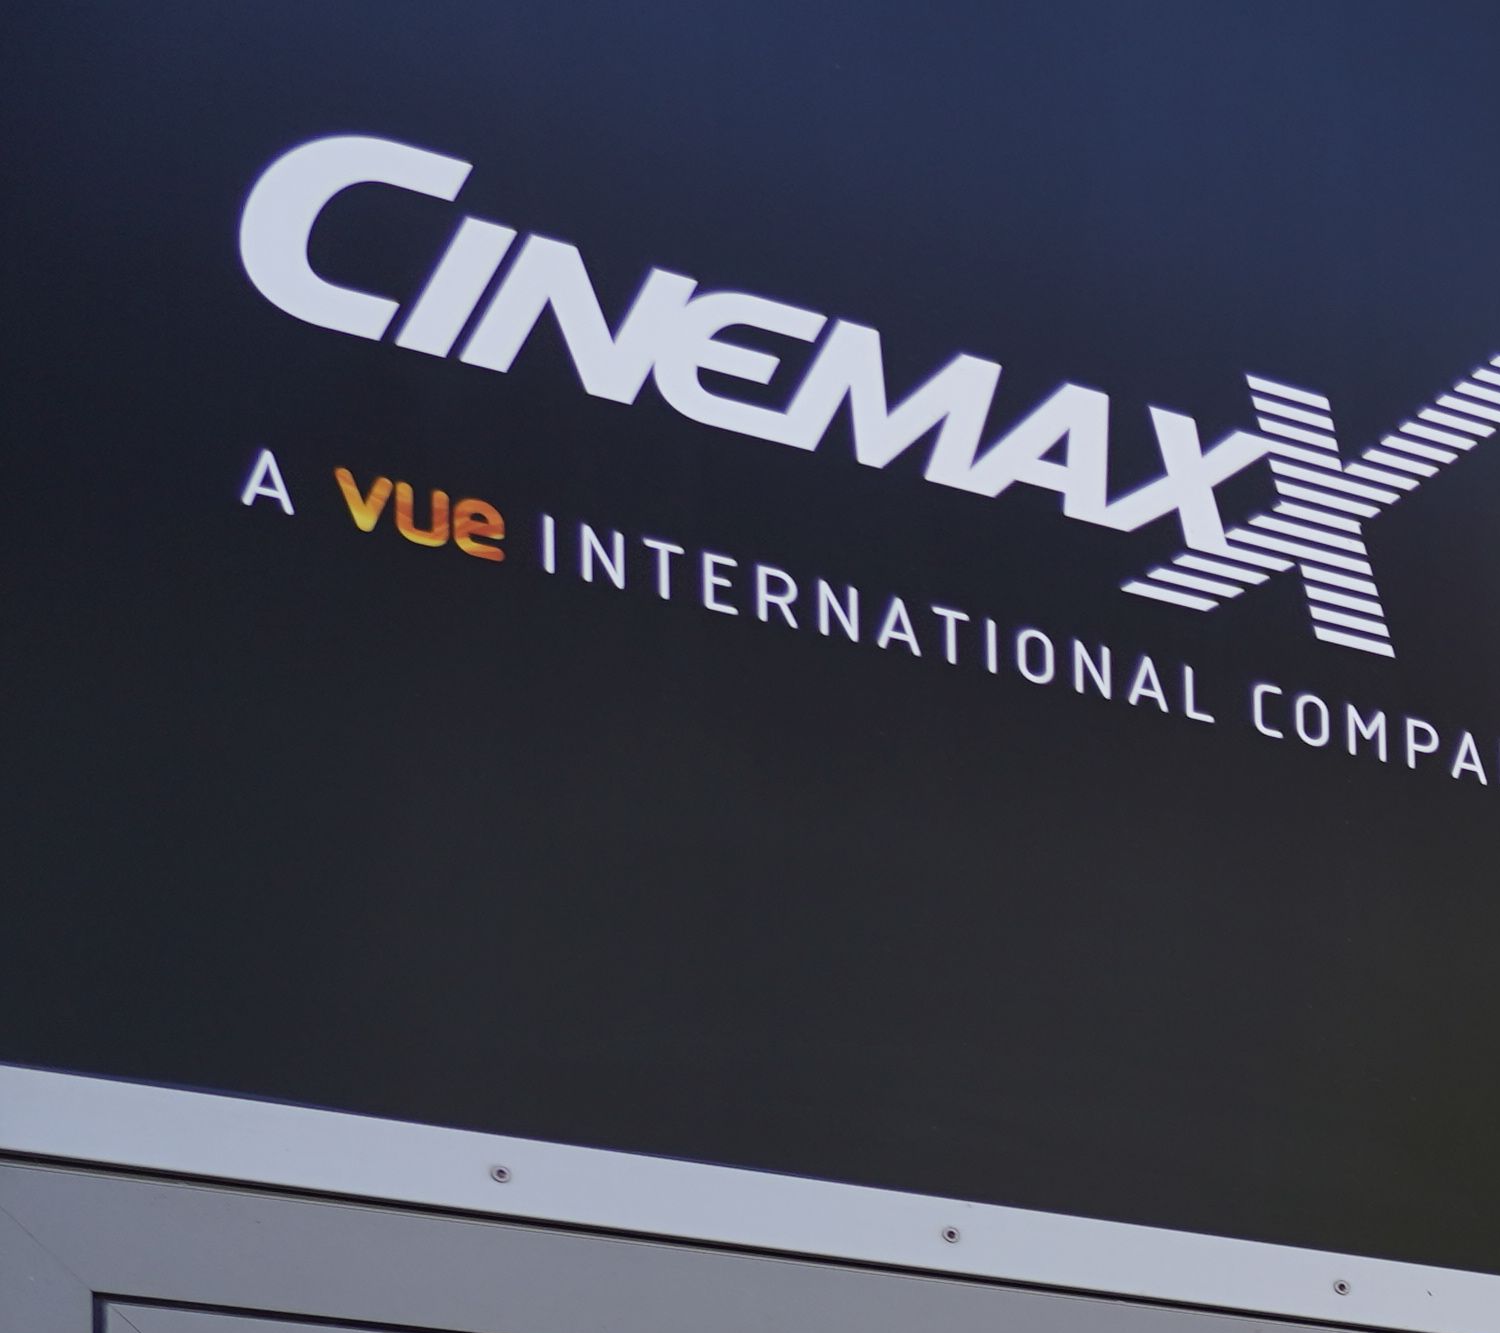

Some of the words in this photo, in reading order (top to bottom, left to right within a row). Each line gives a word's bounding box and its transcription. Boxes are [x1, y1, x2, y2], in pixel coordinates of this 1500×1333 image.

[240, 448, 294, 515] A
[335, 466, 506, 562] vue
[540, 513, 1214, 724] INTERNATIONAL
